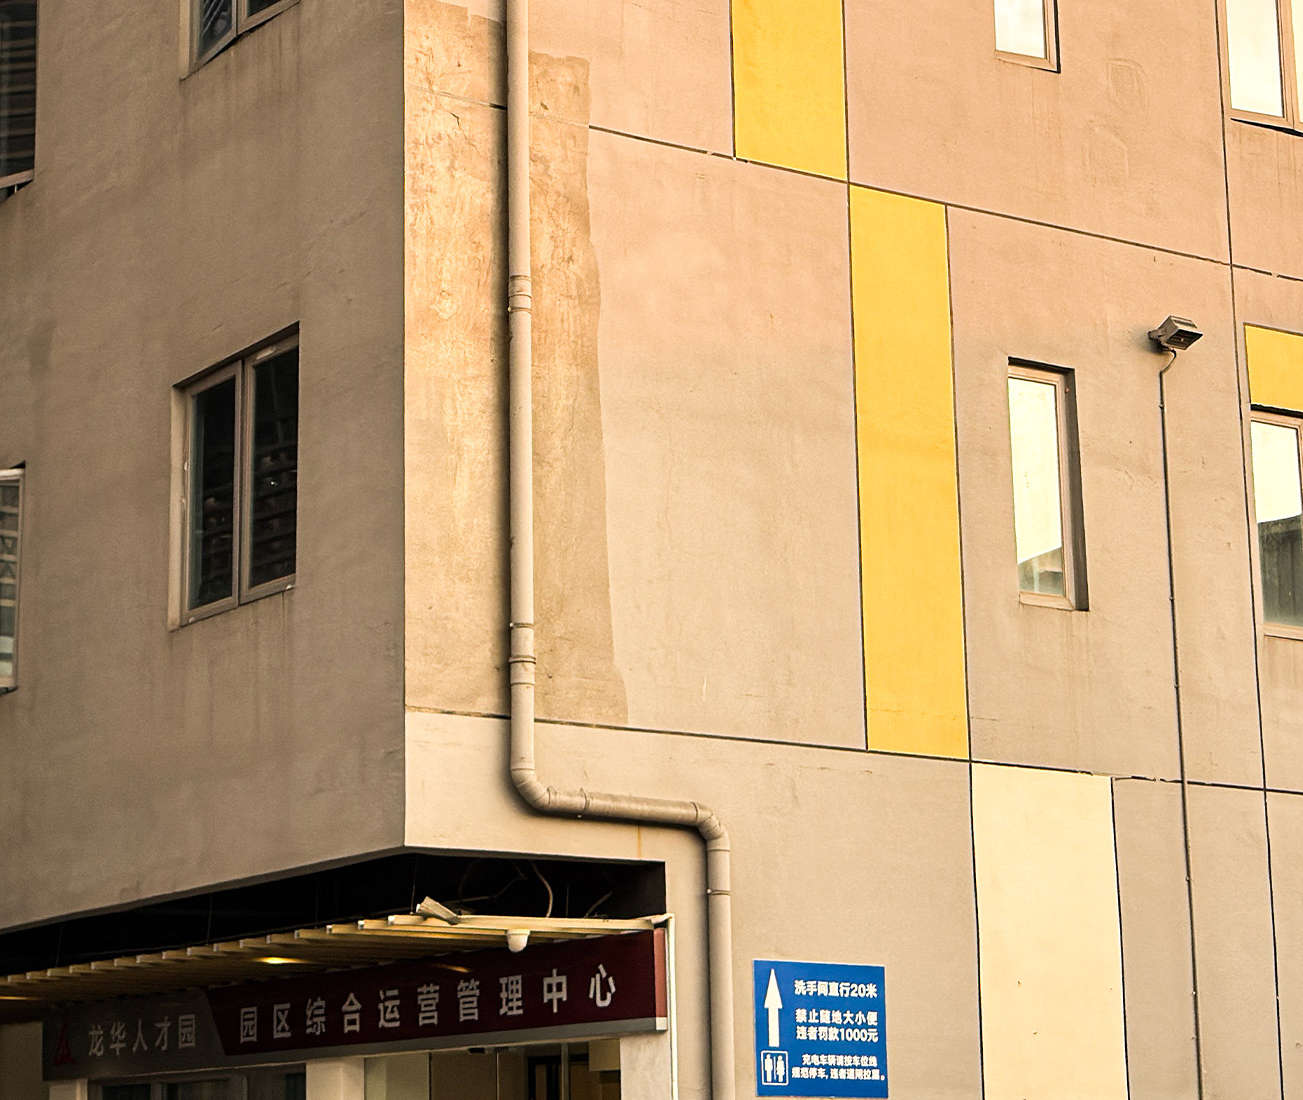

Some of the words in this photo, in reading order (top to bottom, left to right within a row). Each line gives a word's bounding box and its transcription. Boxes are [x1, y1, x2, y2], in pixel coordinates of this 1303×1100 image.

[794, 979, 877, 998] 洗手间直行20米
[239, 964, 616, 1044] 园区综合运营管理中心
[795, 1008, 878, 1025] 禁止随地大小便
[88, 1014, 196, 1057] 龙华人才园
[796, 1026, 878, 1042] 违者罚款1000元
[802, 1053, 877, 1067] 充电车辆请按车位线
